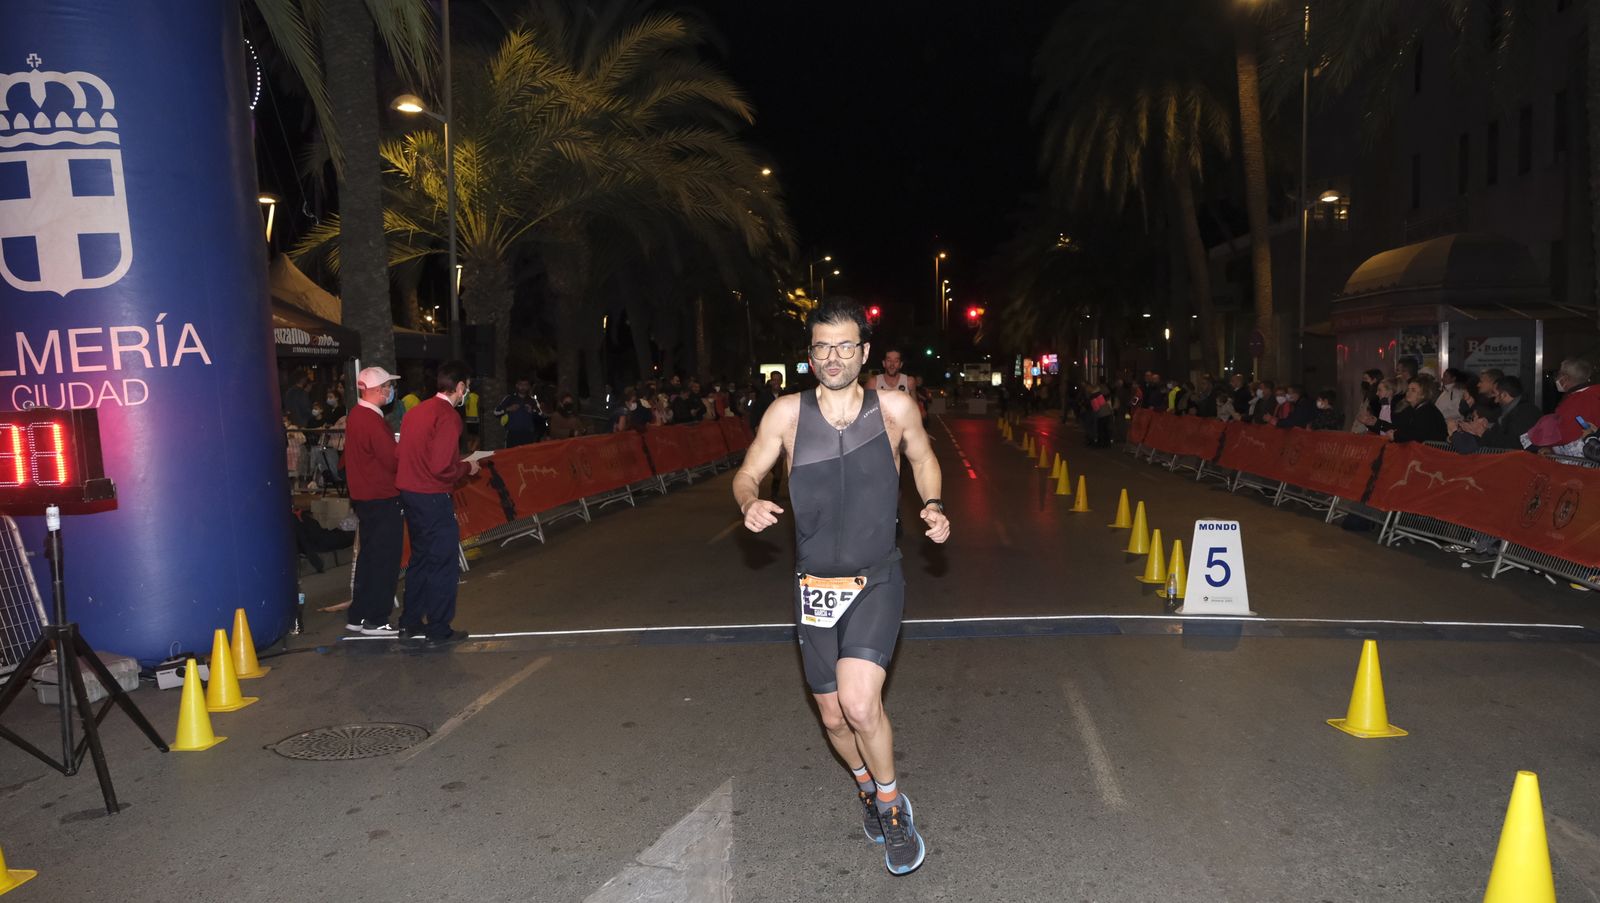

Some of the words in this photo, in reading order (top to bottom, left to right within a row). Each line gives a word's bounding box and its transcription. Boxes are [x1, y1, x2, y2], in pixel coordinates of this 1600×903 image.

[0, 312, 212, 377] MERÍA
[11, 378, 149, 411] CIUDAD
[1198, 523, 1237, 531] MONDO
[1204, 546, 1231, 588] 5
